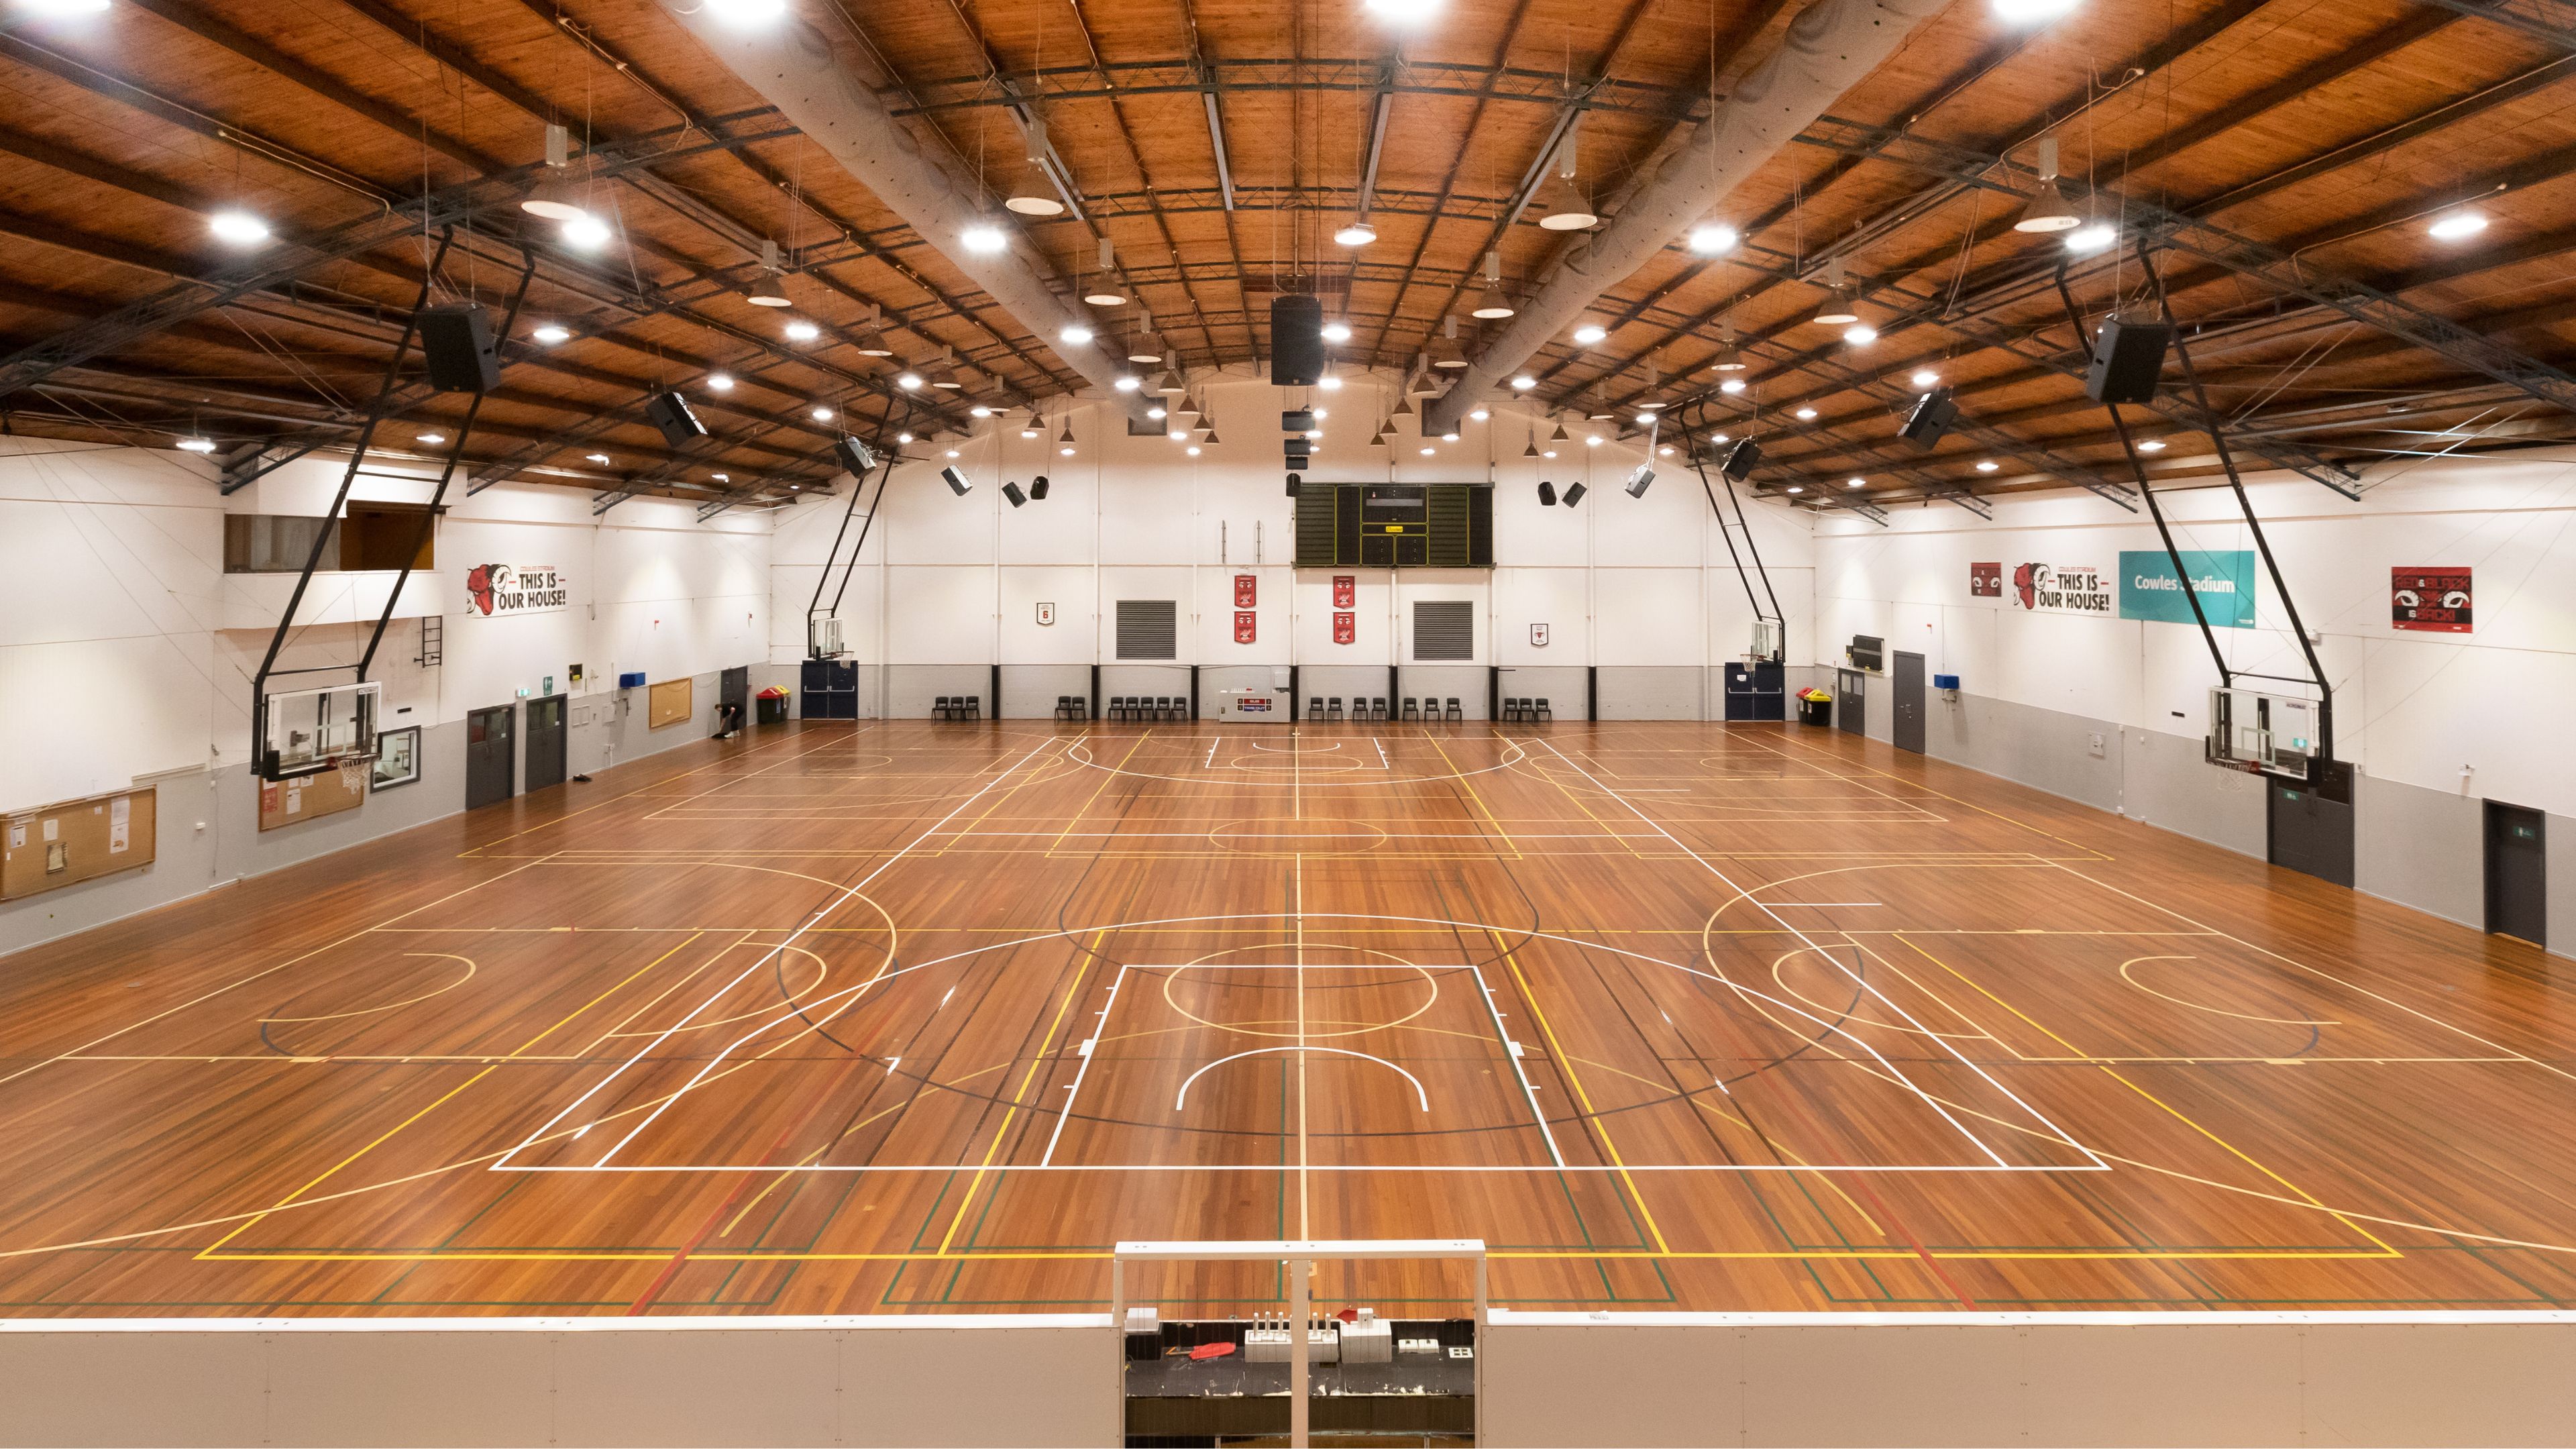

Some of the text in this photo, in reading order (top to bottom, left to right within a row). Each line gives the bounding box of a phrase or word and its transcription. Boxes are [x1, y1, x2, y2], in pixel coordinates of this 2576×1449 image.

[519, 572, 556, 590] THIS IS
[2057, 574, 2098, 591] THIS IS
[2135, 575, 2178, 591] Cowles
[498, 590, 566, 610] OUR HOUSE!
[2039, 592, 2109, 611] OUR HOUSE!
[1043, 610, 1048, 619] 6
